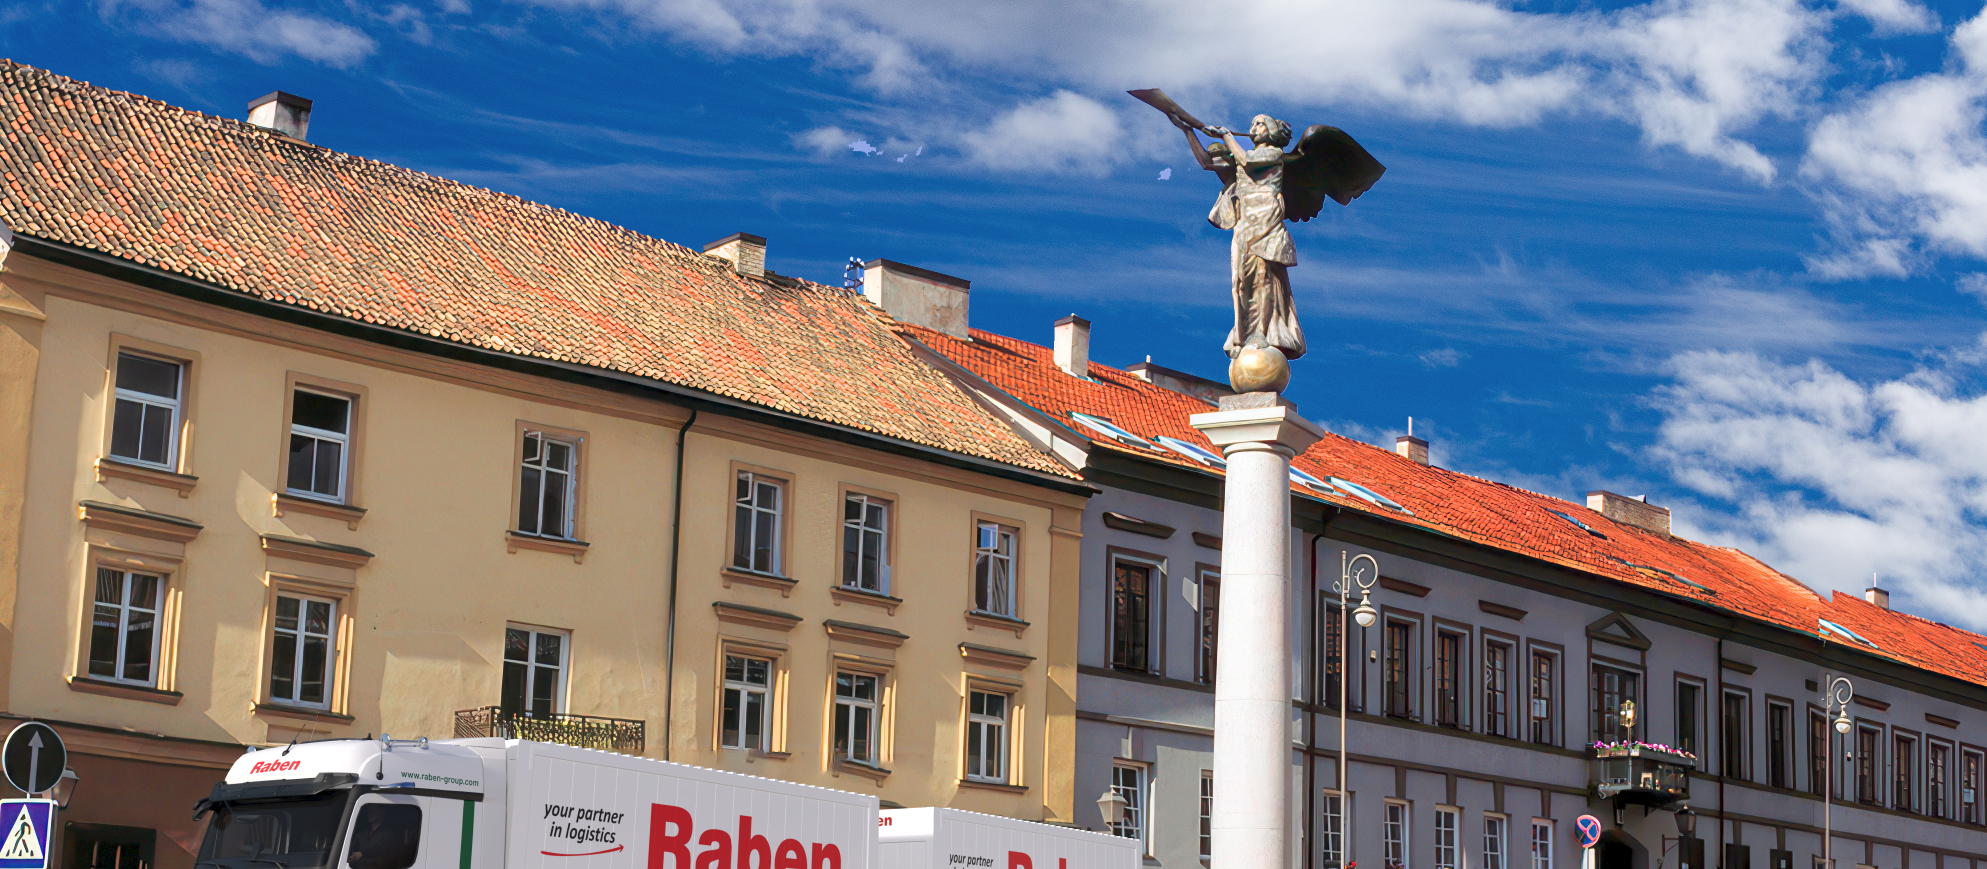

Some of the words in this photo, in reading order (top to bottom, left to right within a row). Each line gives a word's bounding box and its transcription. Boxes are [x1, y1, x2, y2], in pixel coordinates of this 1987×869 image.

[249, 758, 301, 774] Raben
[400, 771, 479, 787] www.raben-group.com
[544, 803, 575, 820] your
[575, 808, 625, 824] partner
[549, 821, 563, 838] in
[565, 822, 616, 844] logistics
[948, 853, 967, 866] your
[966, 855, 994, 868] partner
